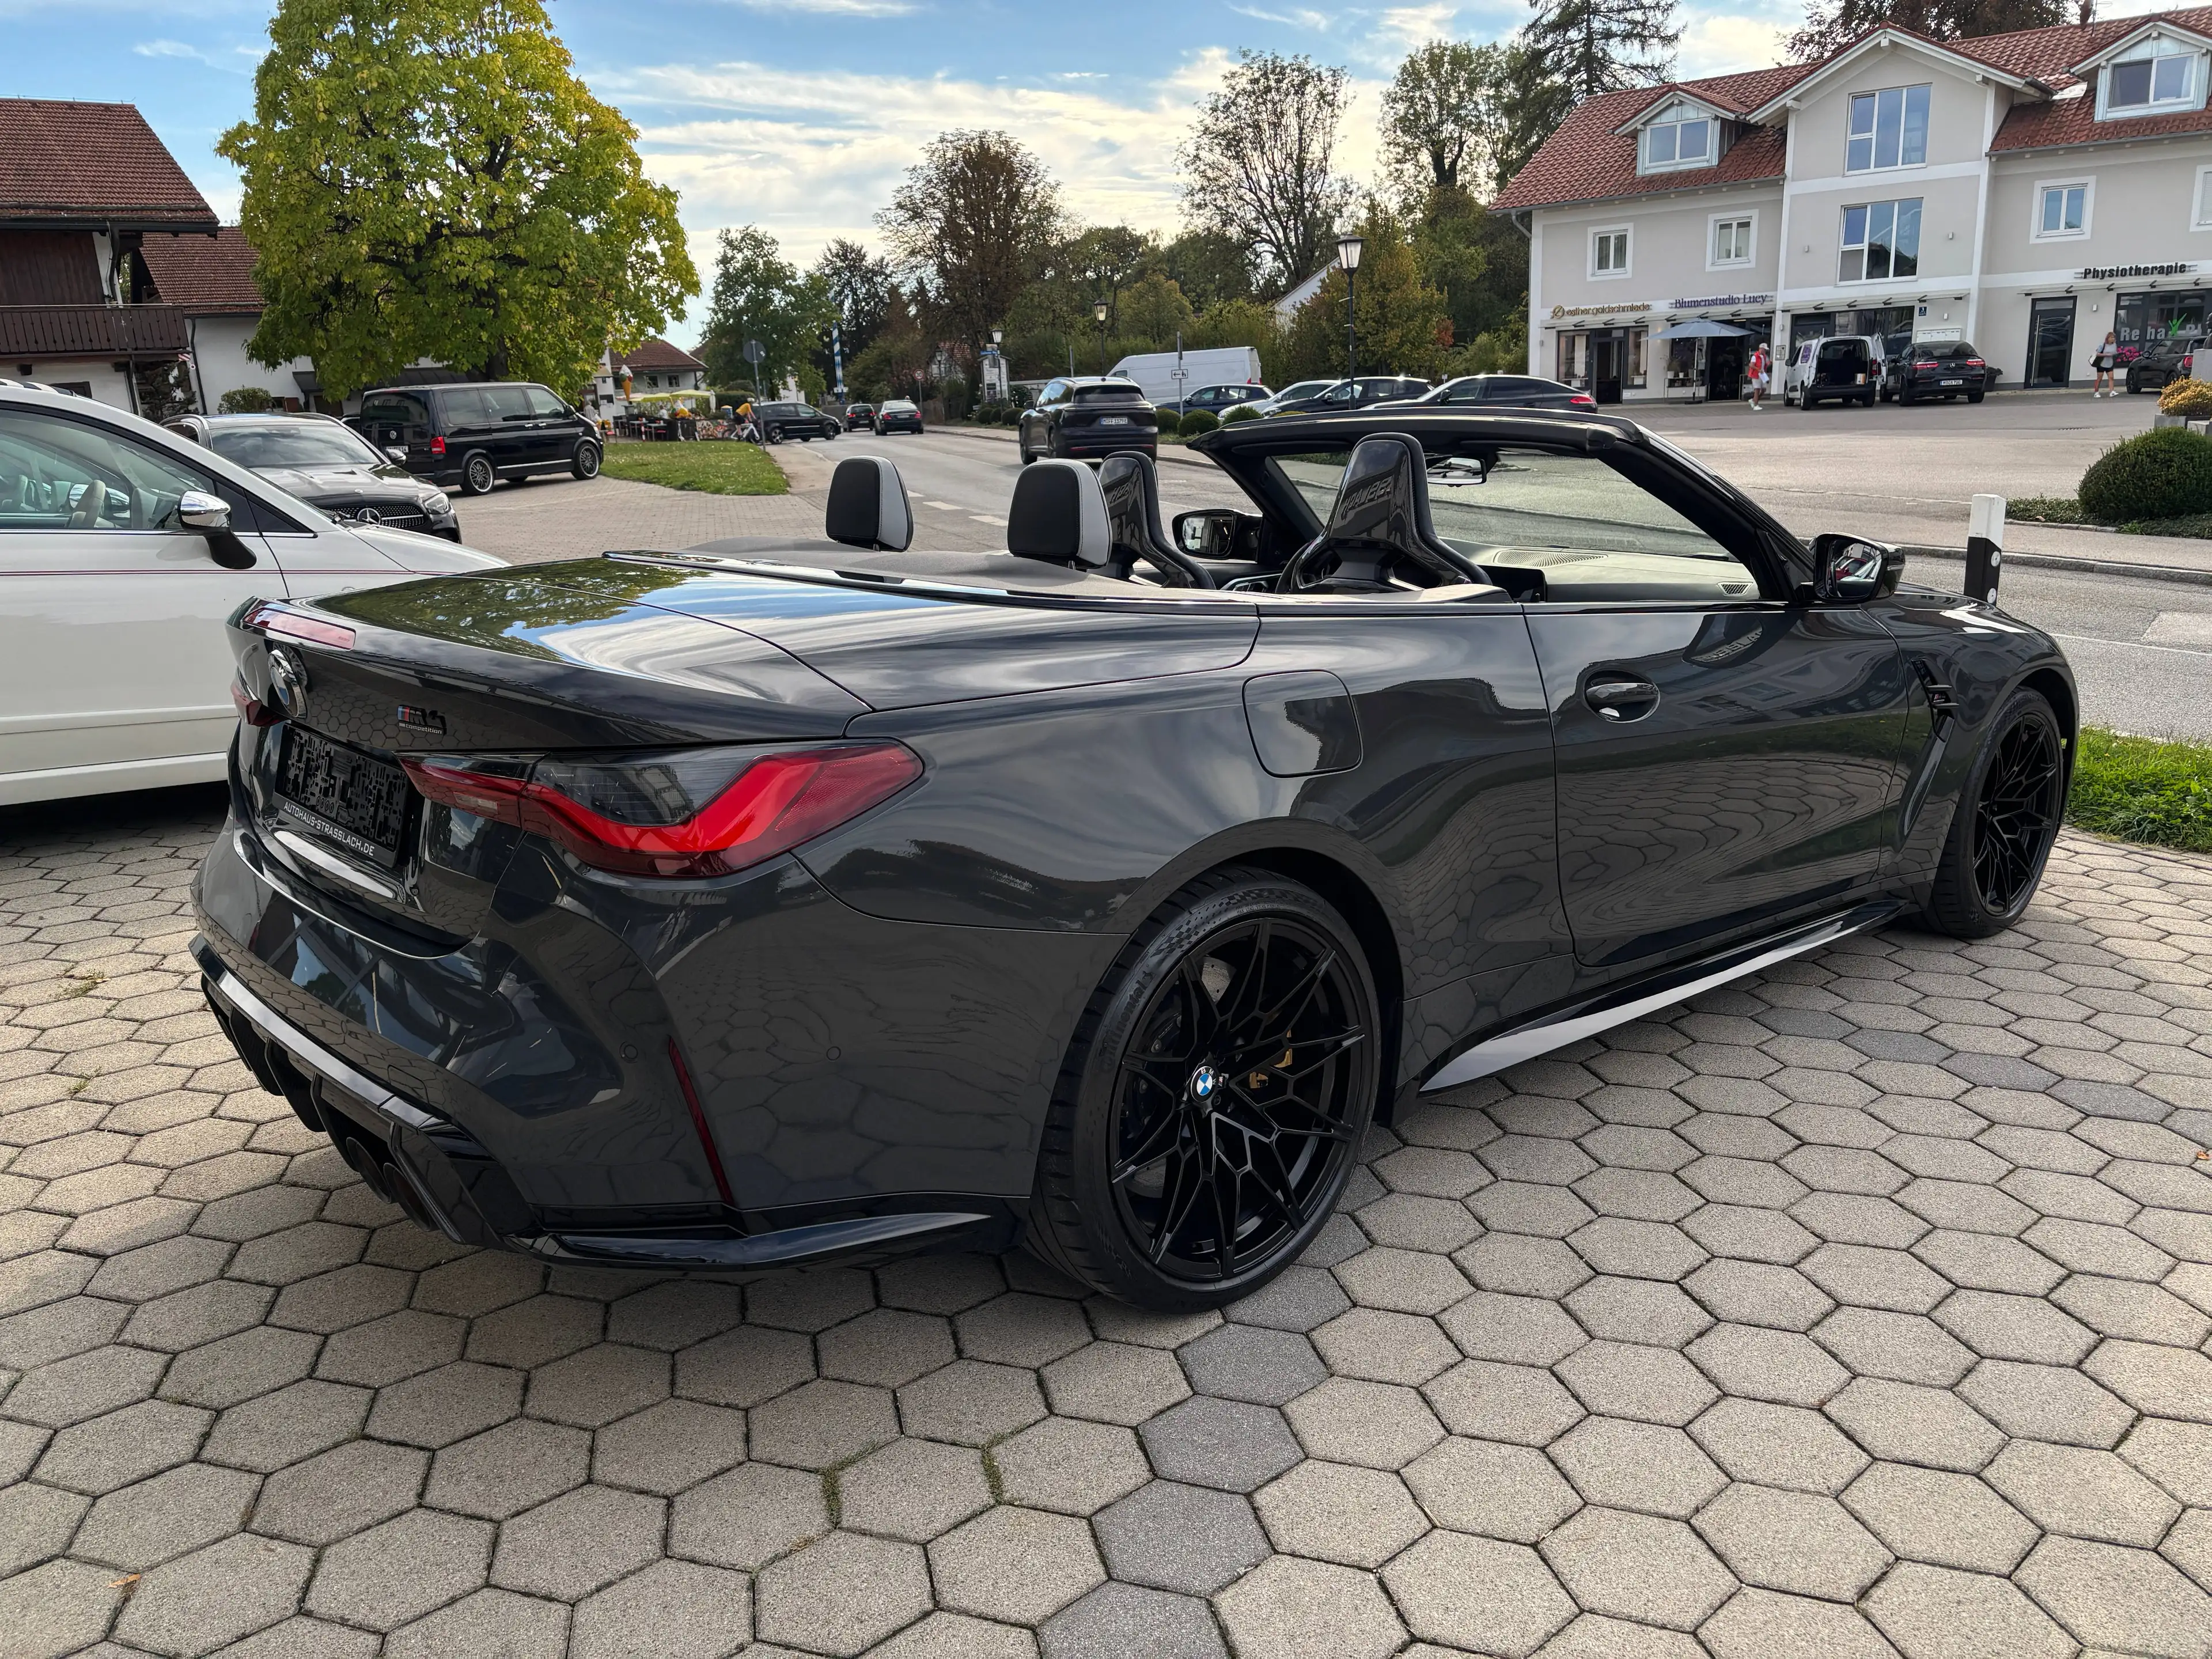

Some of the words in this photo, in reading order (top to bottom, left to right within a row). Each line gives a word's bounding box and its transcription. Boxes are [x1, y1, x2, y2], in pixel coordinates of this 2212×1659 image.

[2083, 262, 2187, 280] Physiotherapie
[1675, 294, 1740, 309] Blumenstudio
[1743, 294, 1768, 305] Lucy
[405, 724, 442, 734] competition
[1201, 1067, 1217, 1085] BMW
